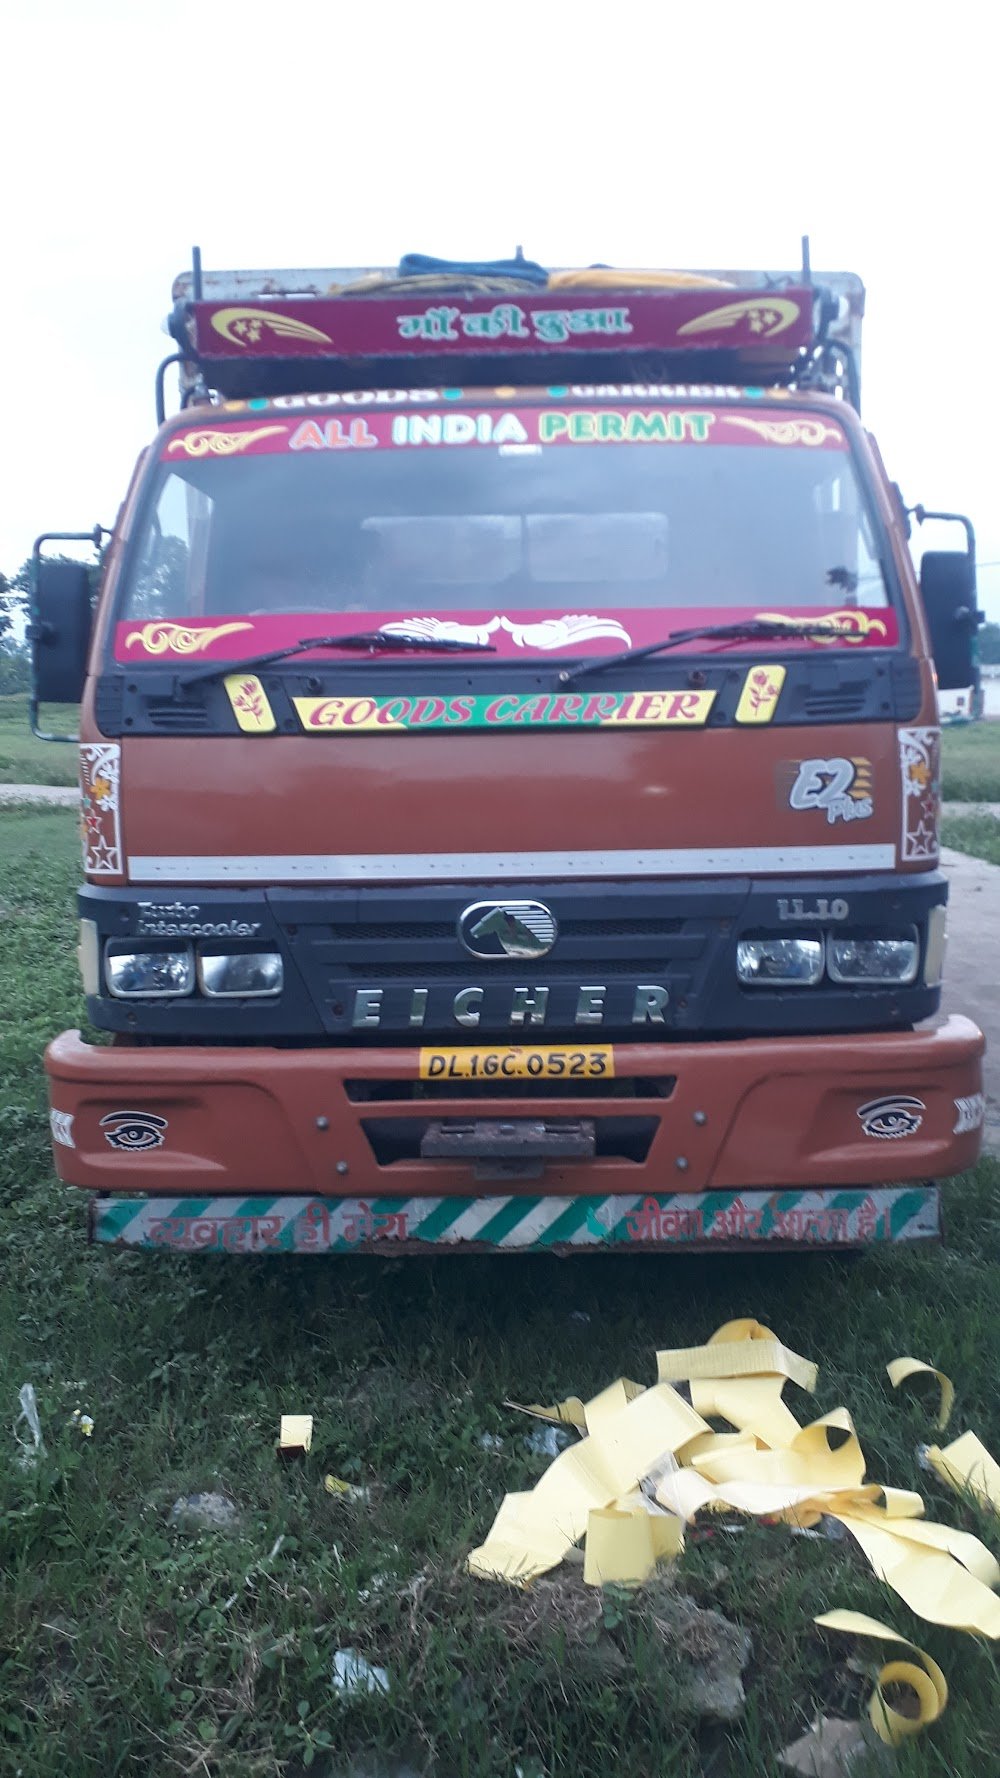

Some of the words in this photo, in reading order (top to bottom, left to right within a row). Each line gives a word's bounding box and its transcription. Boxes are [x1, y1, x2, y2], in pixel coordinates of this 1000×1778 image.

[460, 304, 530, 339] की
[531, 308, 633, 342] दुआ
[289, 418, 378, 450] ALL
[391, 413, 528, 445] INDIA
[538, 411, 715, 442] PERMIT
[309, 697, 476, 726] GOODS
[485, 693, 700, 724] CARRIER
[137, 901, 200, 918] Turbo
[352, 986, 669, 1028] EICHER
[296, 1201, 331, 1250] ही
[712, 1196, 764, 1239] और
